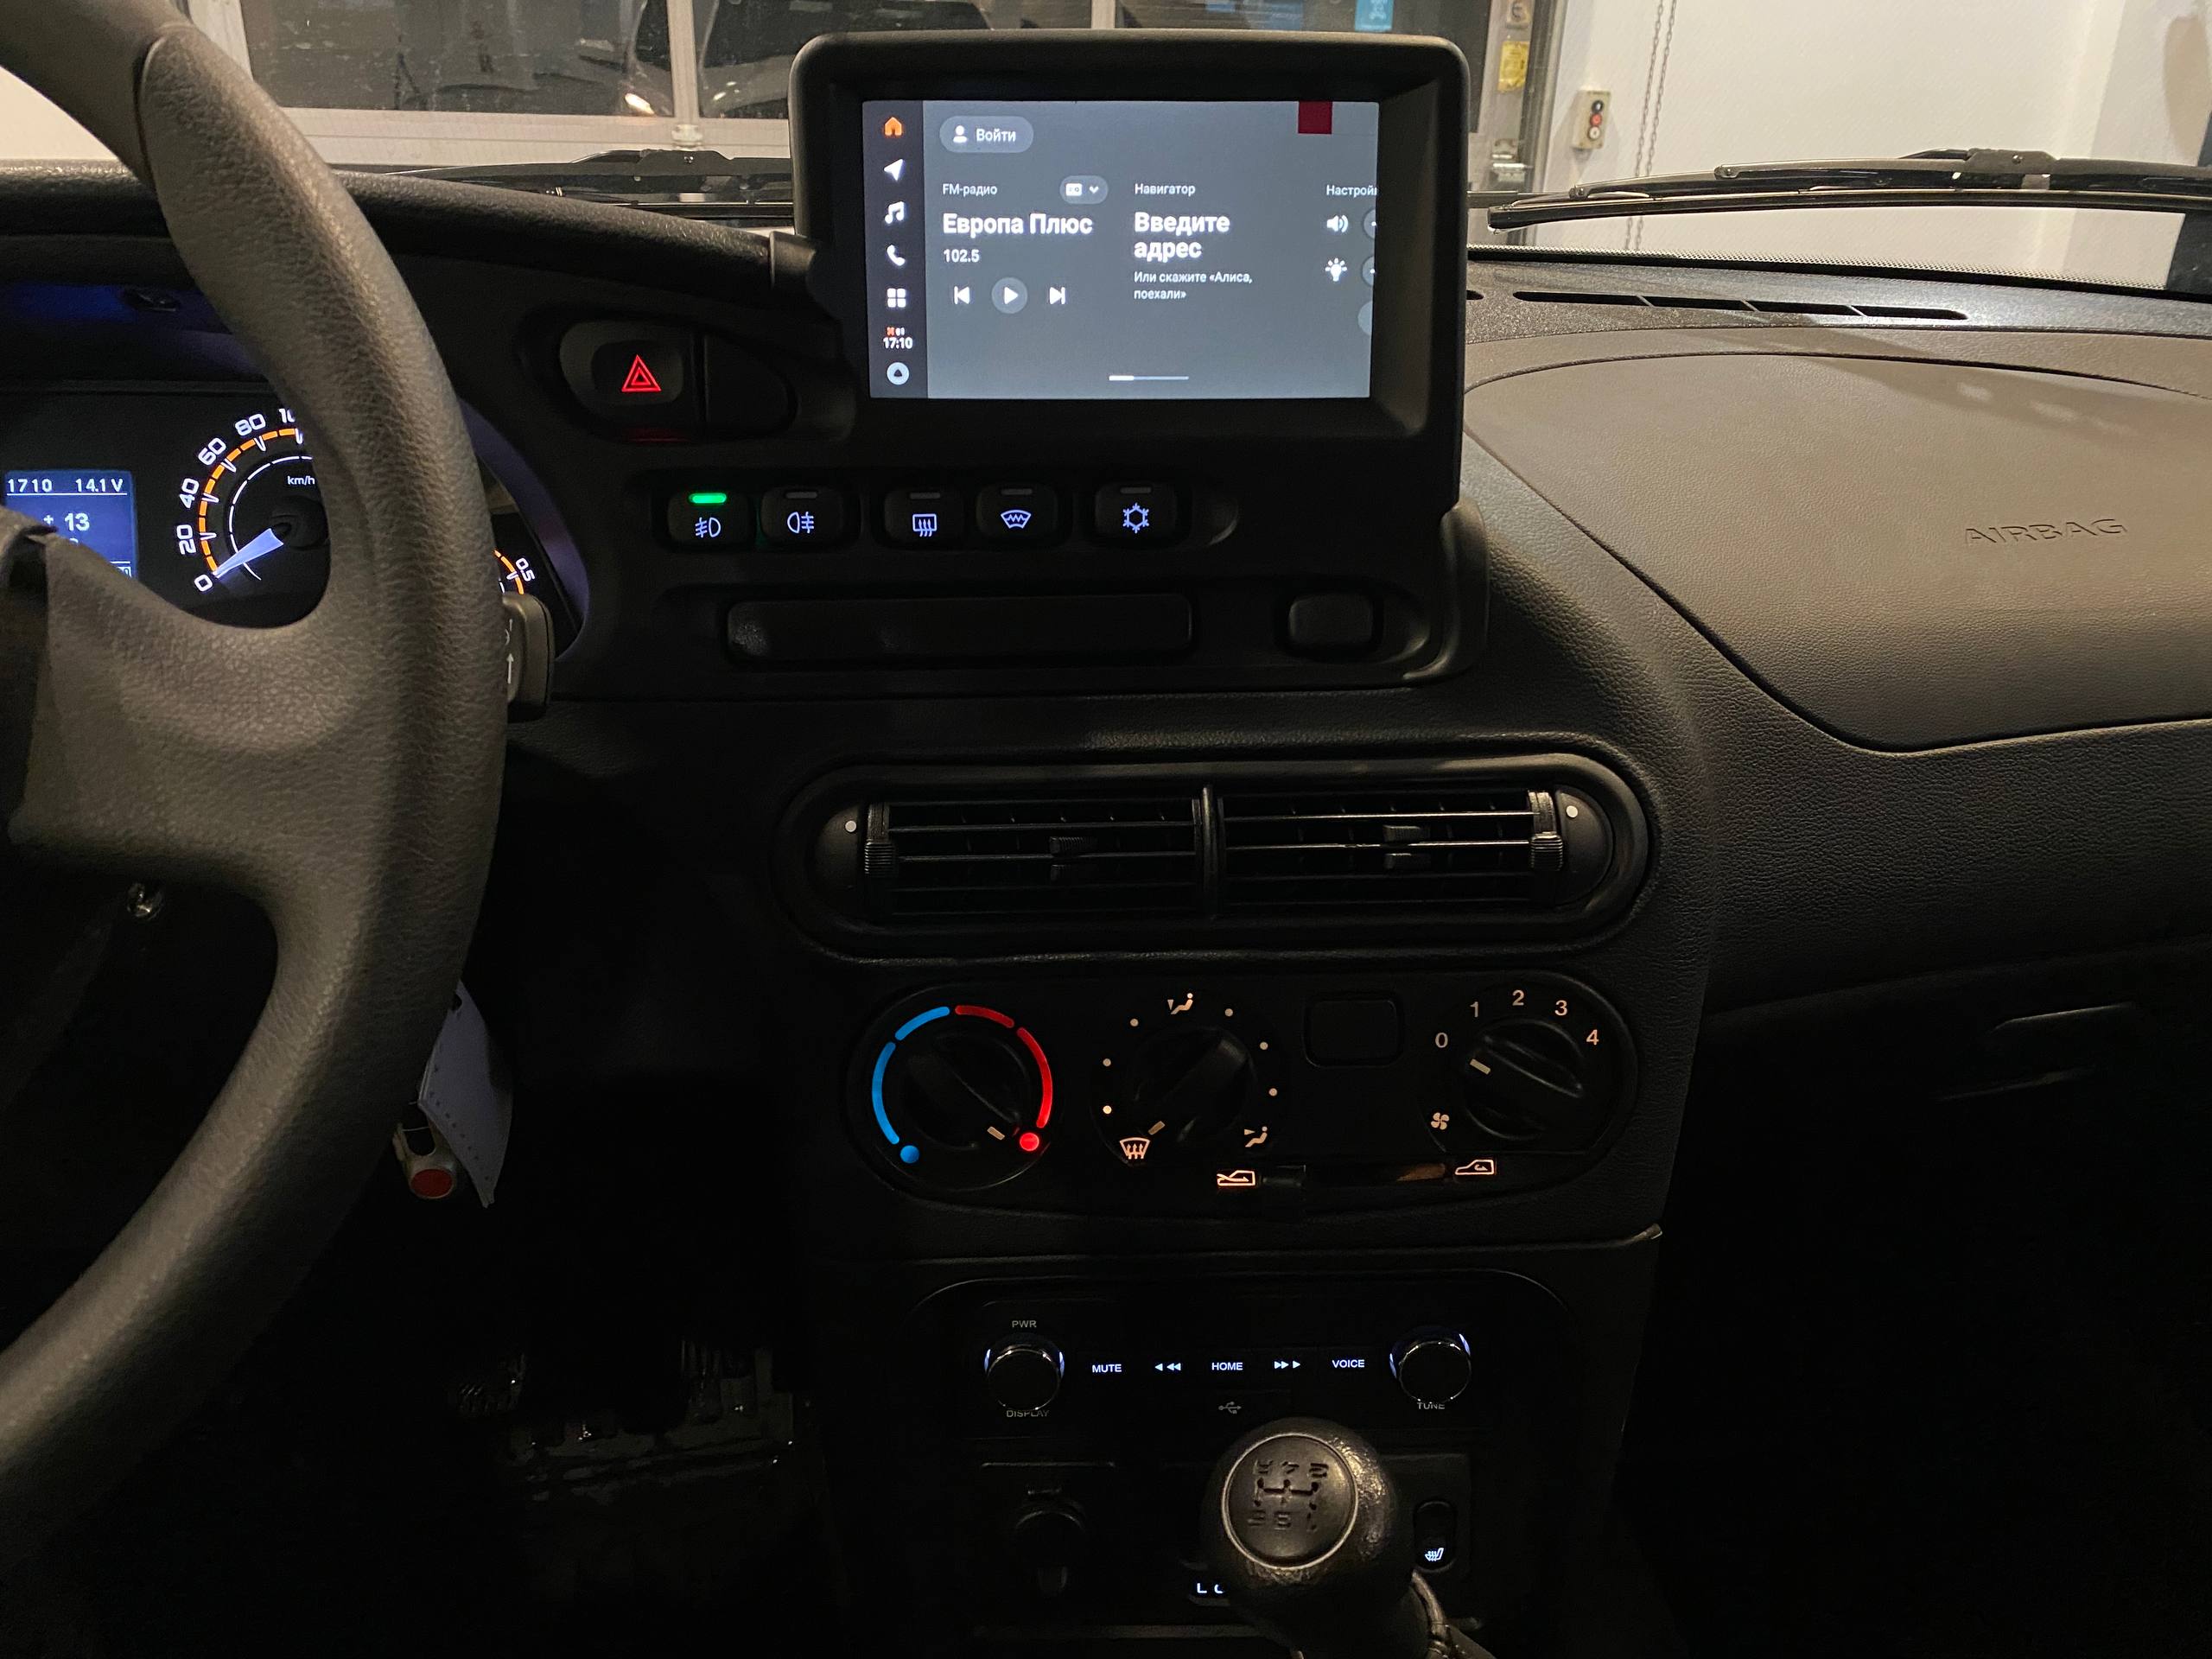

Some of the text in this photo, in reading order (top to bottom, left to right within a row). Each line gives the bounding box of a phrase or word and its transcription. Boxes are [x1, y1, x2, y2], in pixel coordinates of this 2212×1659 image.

[976, 128, 1017, 142] Войти
[942, 183, 998, 197] FM-радио
[1135, 183, 1196, 196] Навигатор
[943, 213, 1093, 238] Европа Плюс
[1135, 212, 1230, 236] Введите
[943, 249, 980, 263] 102.5
[1134, 241, 1202, 263] адрес
[1134, 271, 1253, 284] Или скажите «Алиса,
[1134, 289, 1187, 300] поехали»
[883, 336, 913, 349] 17:10
[234, 413, 266, 436] 80
[198, 437, 226, 466] 60
[8, 478, 54, 493] 1710
[287, 475, 315, 486] km/h
[179, 478, 200, 509] 40
[1964, 518, 2127, 545] AIRBAG
[176, 524, 197, 555] 20
[194, 574, 213, 593] 0
[1512, 989, 1525, 1007] 2
[1470, 1001, 1480, 1018] 1
[1554, 1000, 1568, 1016] 3
[1434, 1032, 1449, 1049] 0
[1586, 1029, 1599, 1046] 4
[1011, 1319, 1037, 1328] PWR
[1091, 1363, 1122, 1374] MUTE
[1211, 1362, 1243, 1371] HOME
[1332, 1359, 1365, 1369] VOICE
[1416, 1401, 1446, 1410] TUNE
[1006, 1409, 1050, 1418] DISPLAY
